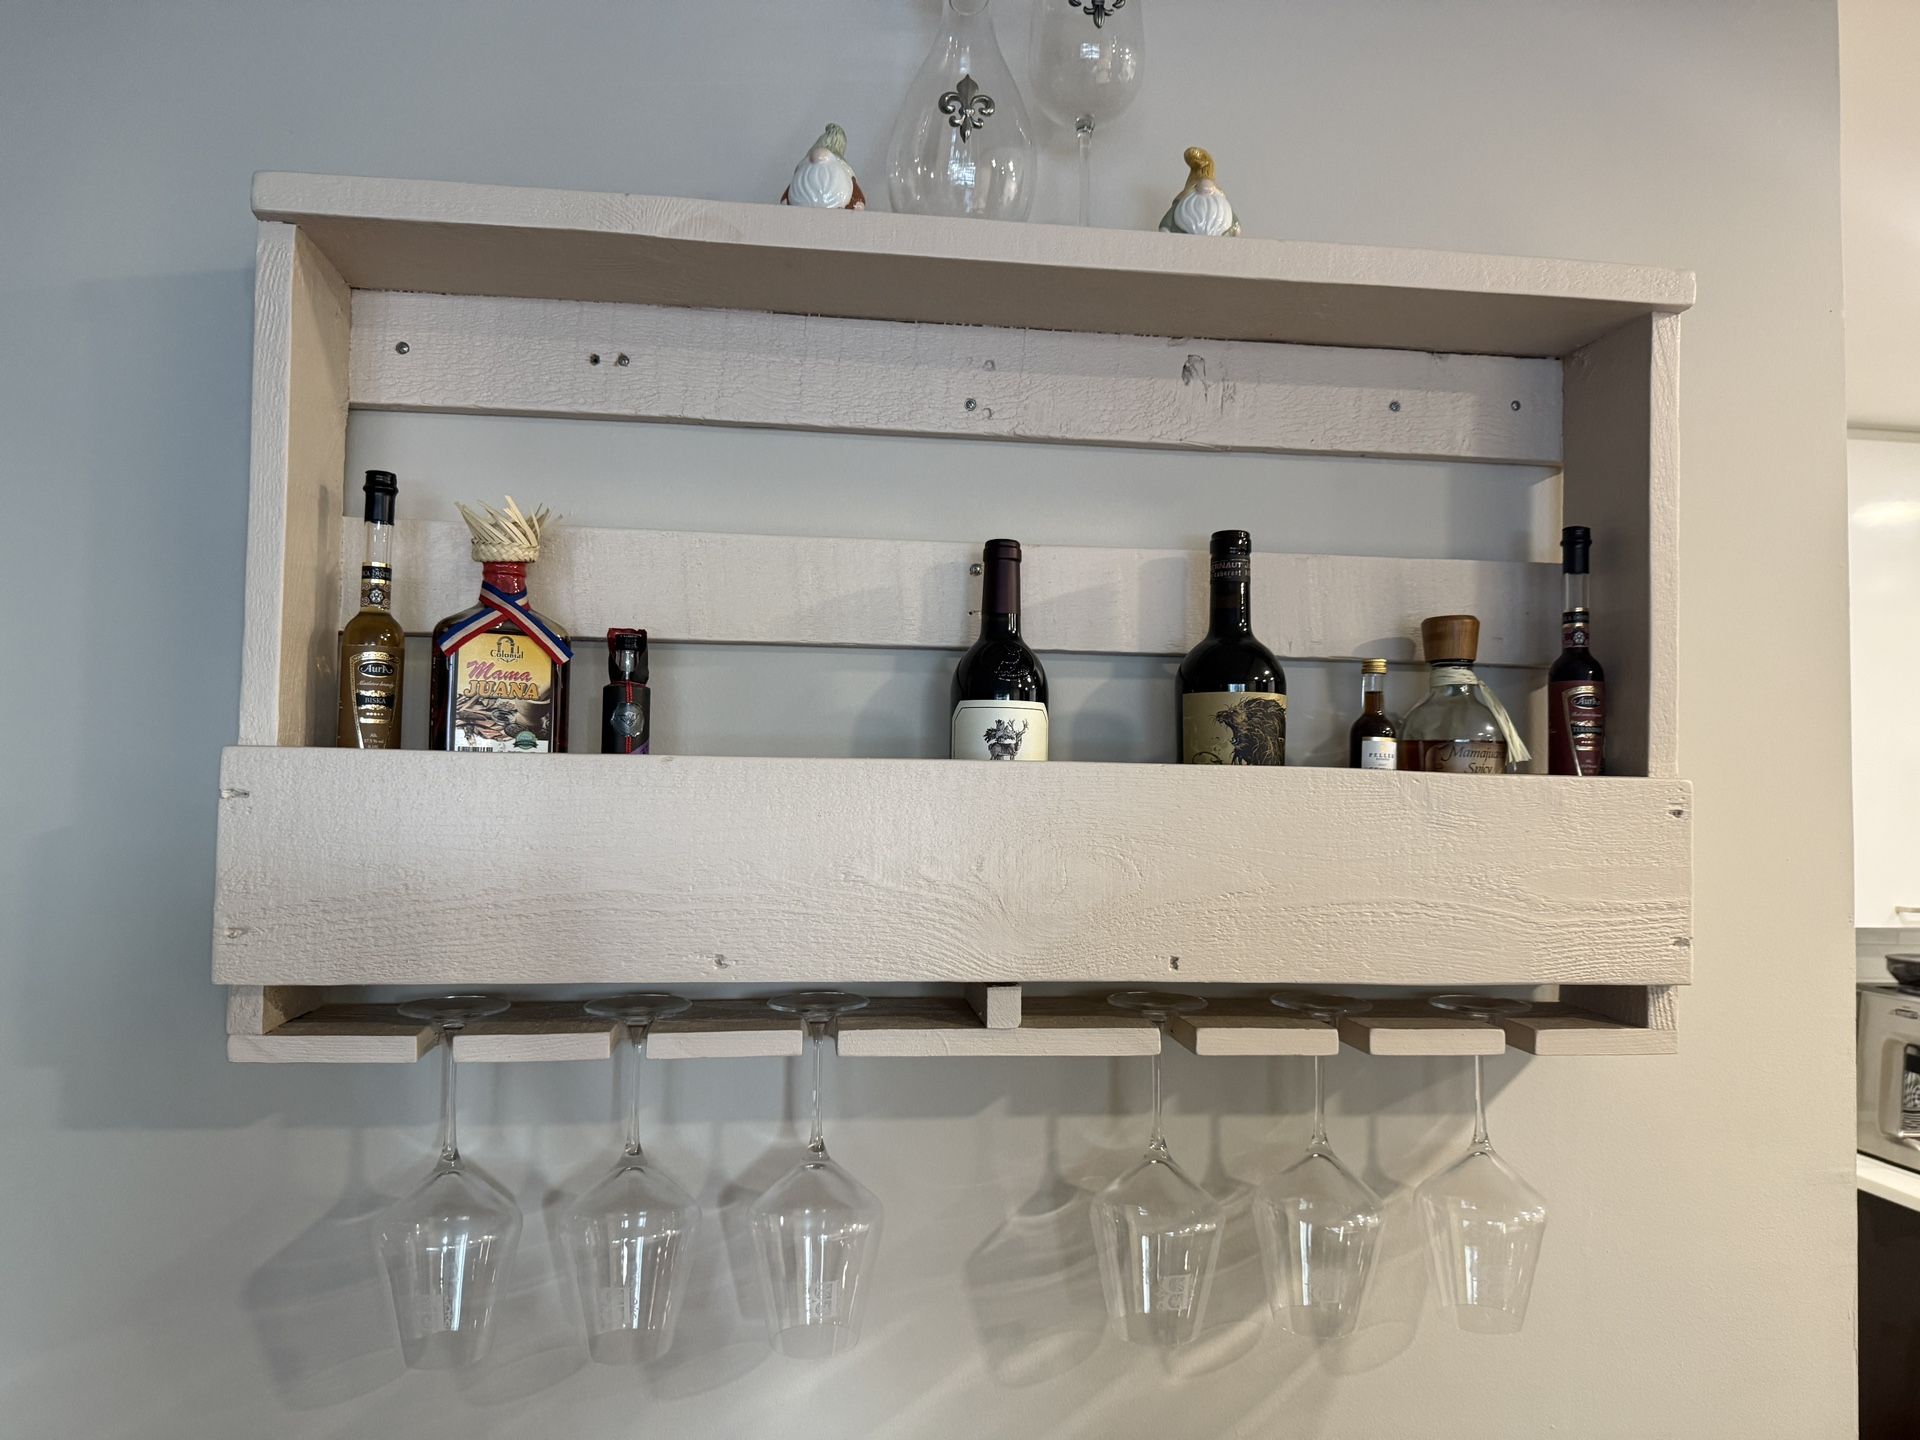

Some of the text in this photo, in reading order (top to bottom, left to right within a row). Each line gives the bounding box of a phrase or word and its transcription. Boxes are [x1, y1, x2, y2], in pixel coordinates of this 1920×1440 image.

[490, 646, 523, 659] Colonial
[466, 660, 533, 682] Mama
[463, 680, 539, 699] JUANA
